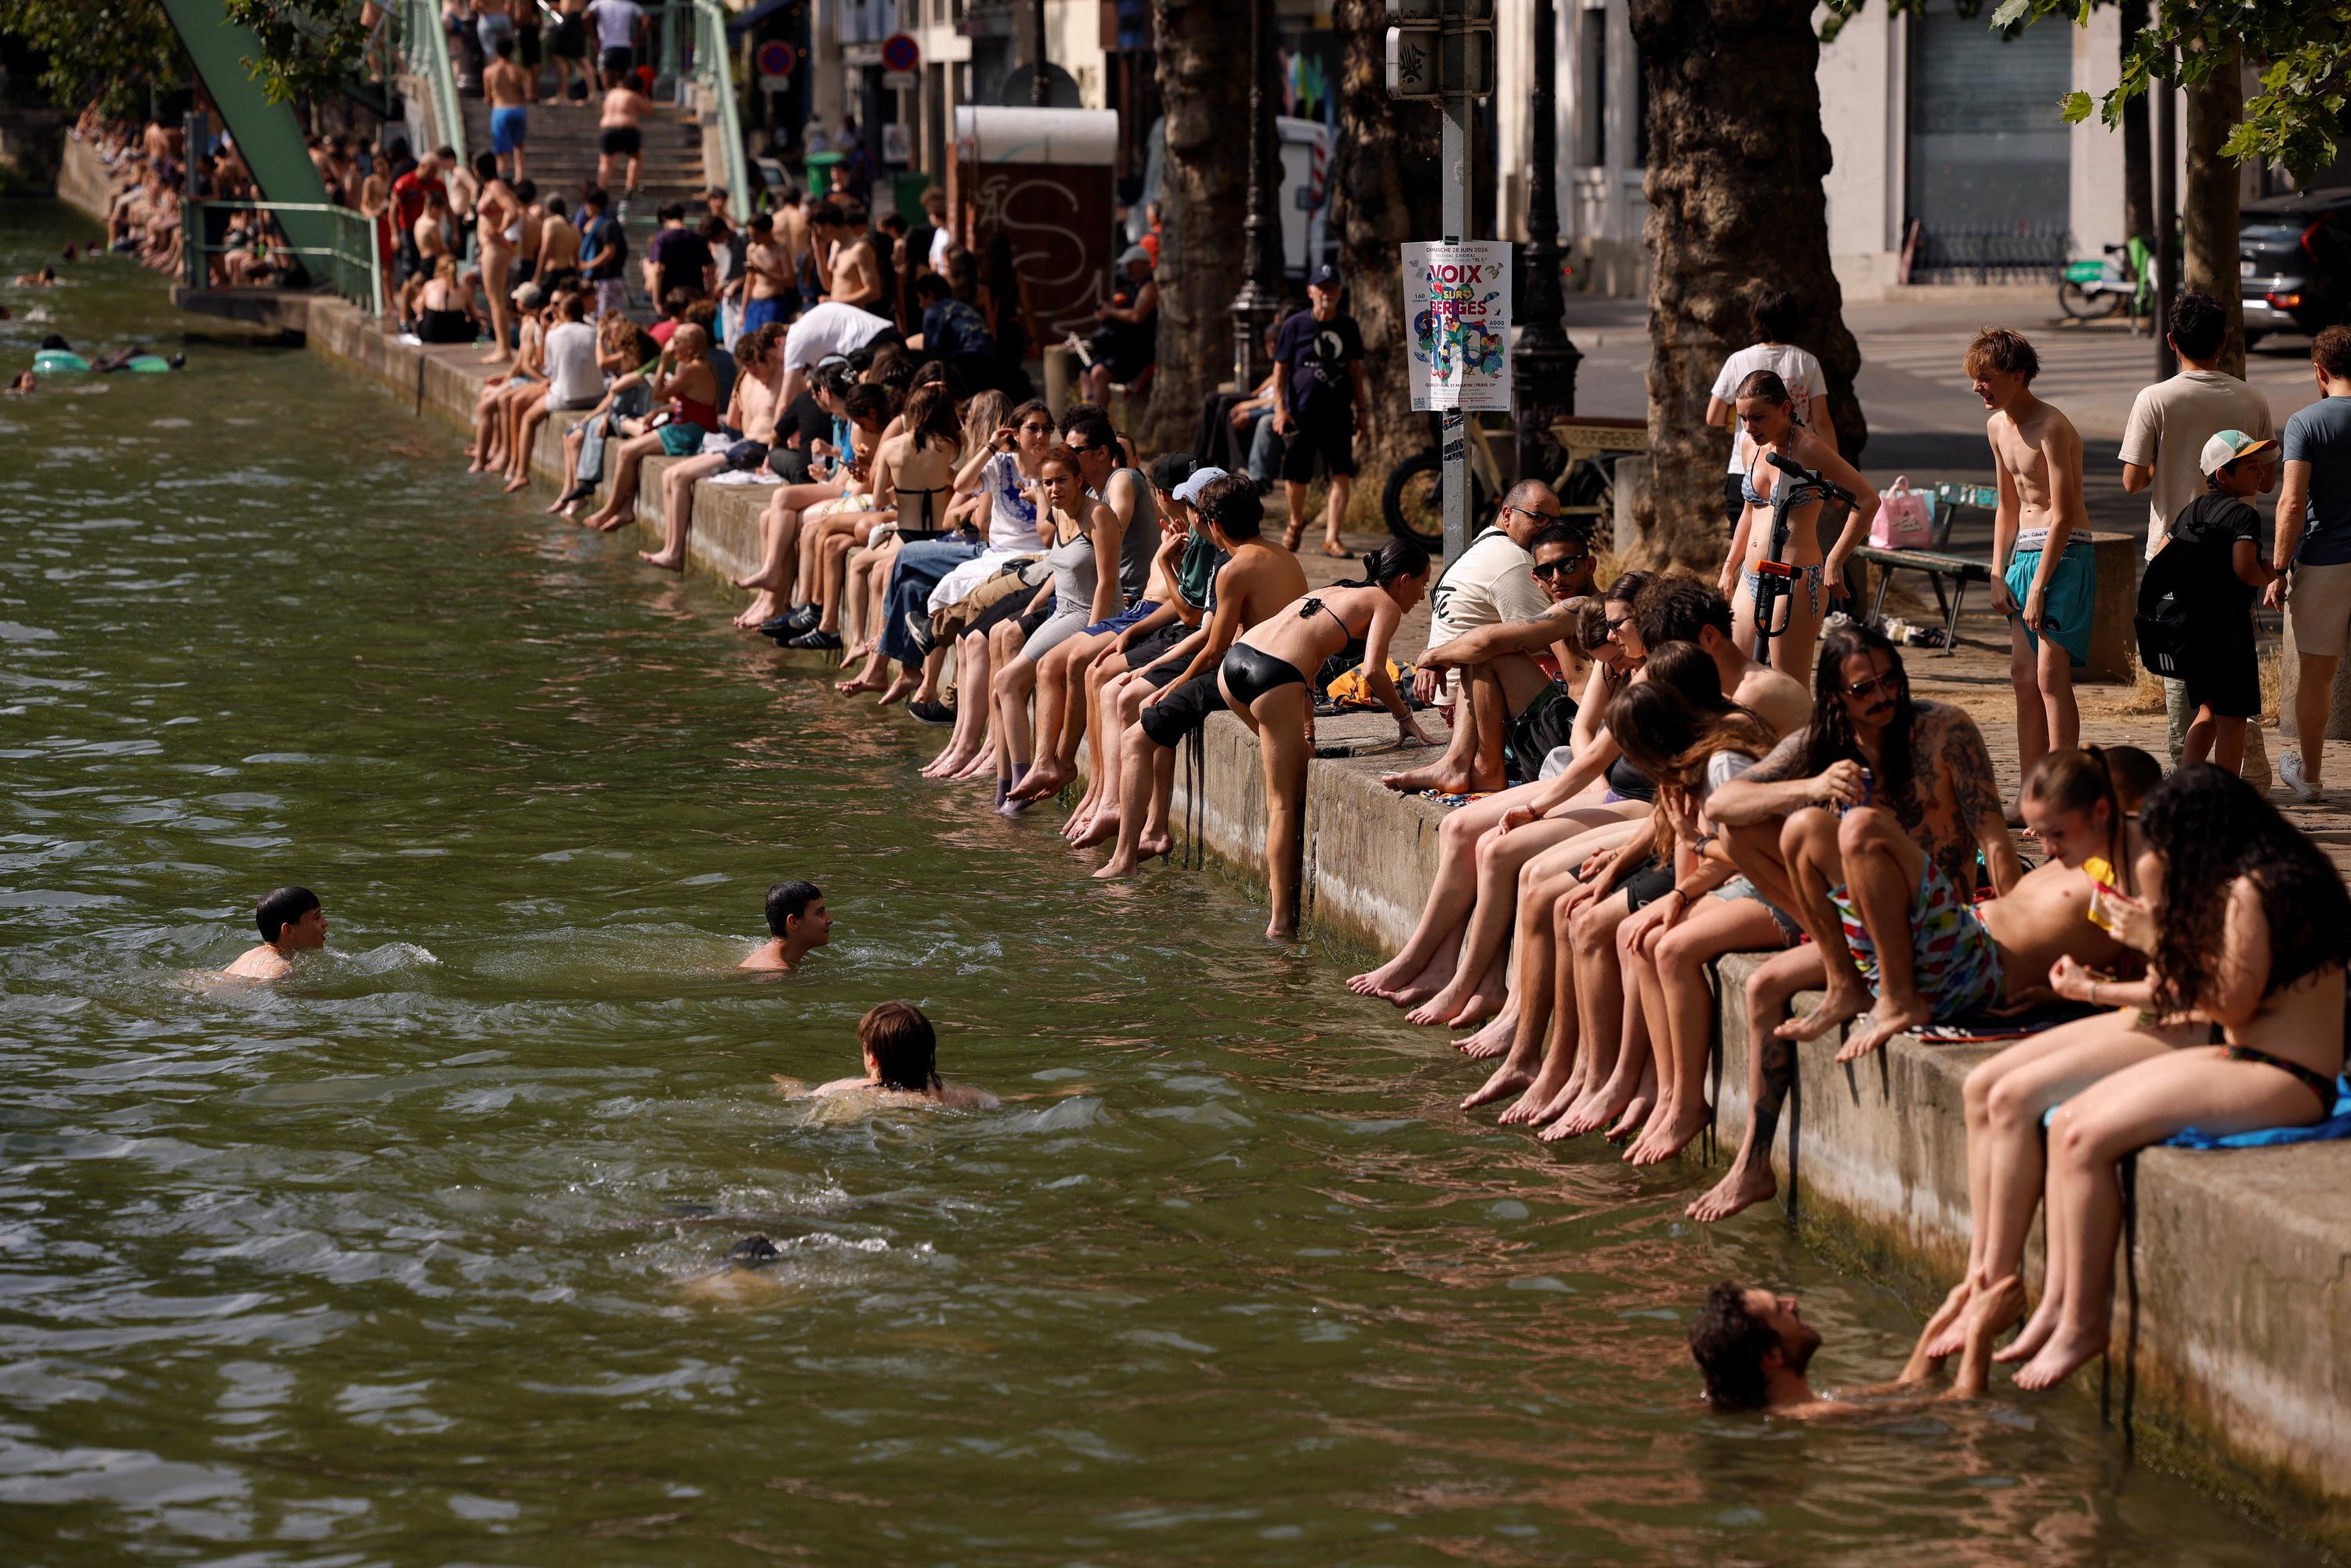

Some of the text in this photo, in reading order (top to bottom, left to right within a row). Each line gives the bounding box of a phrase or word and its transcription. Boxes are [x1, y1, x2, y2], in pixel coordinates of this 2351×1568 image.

[1429, 265, 1482, 283] VOIX
[1444, 290, 1462, 299] SUR
[1430, 301, 1487, 315] BERGES
